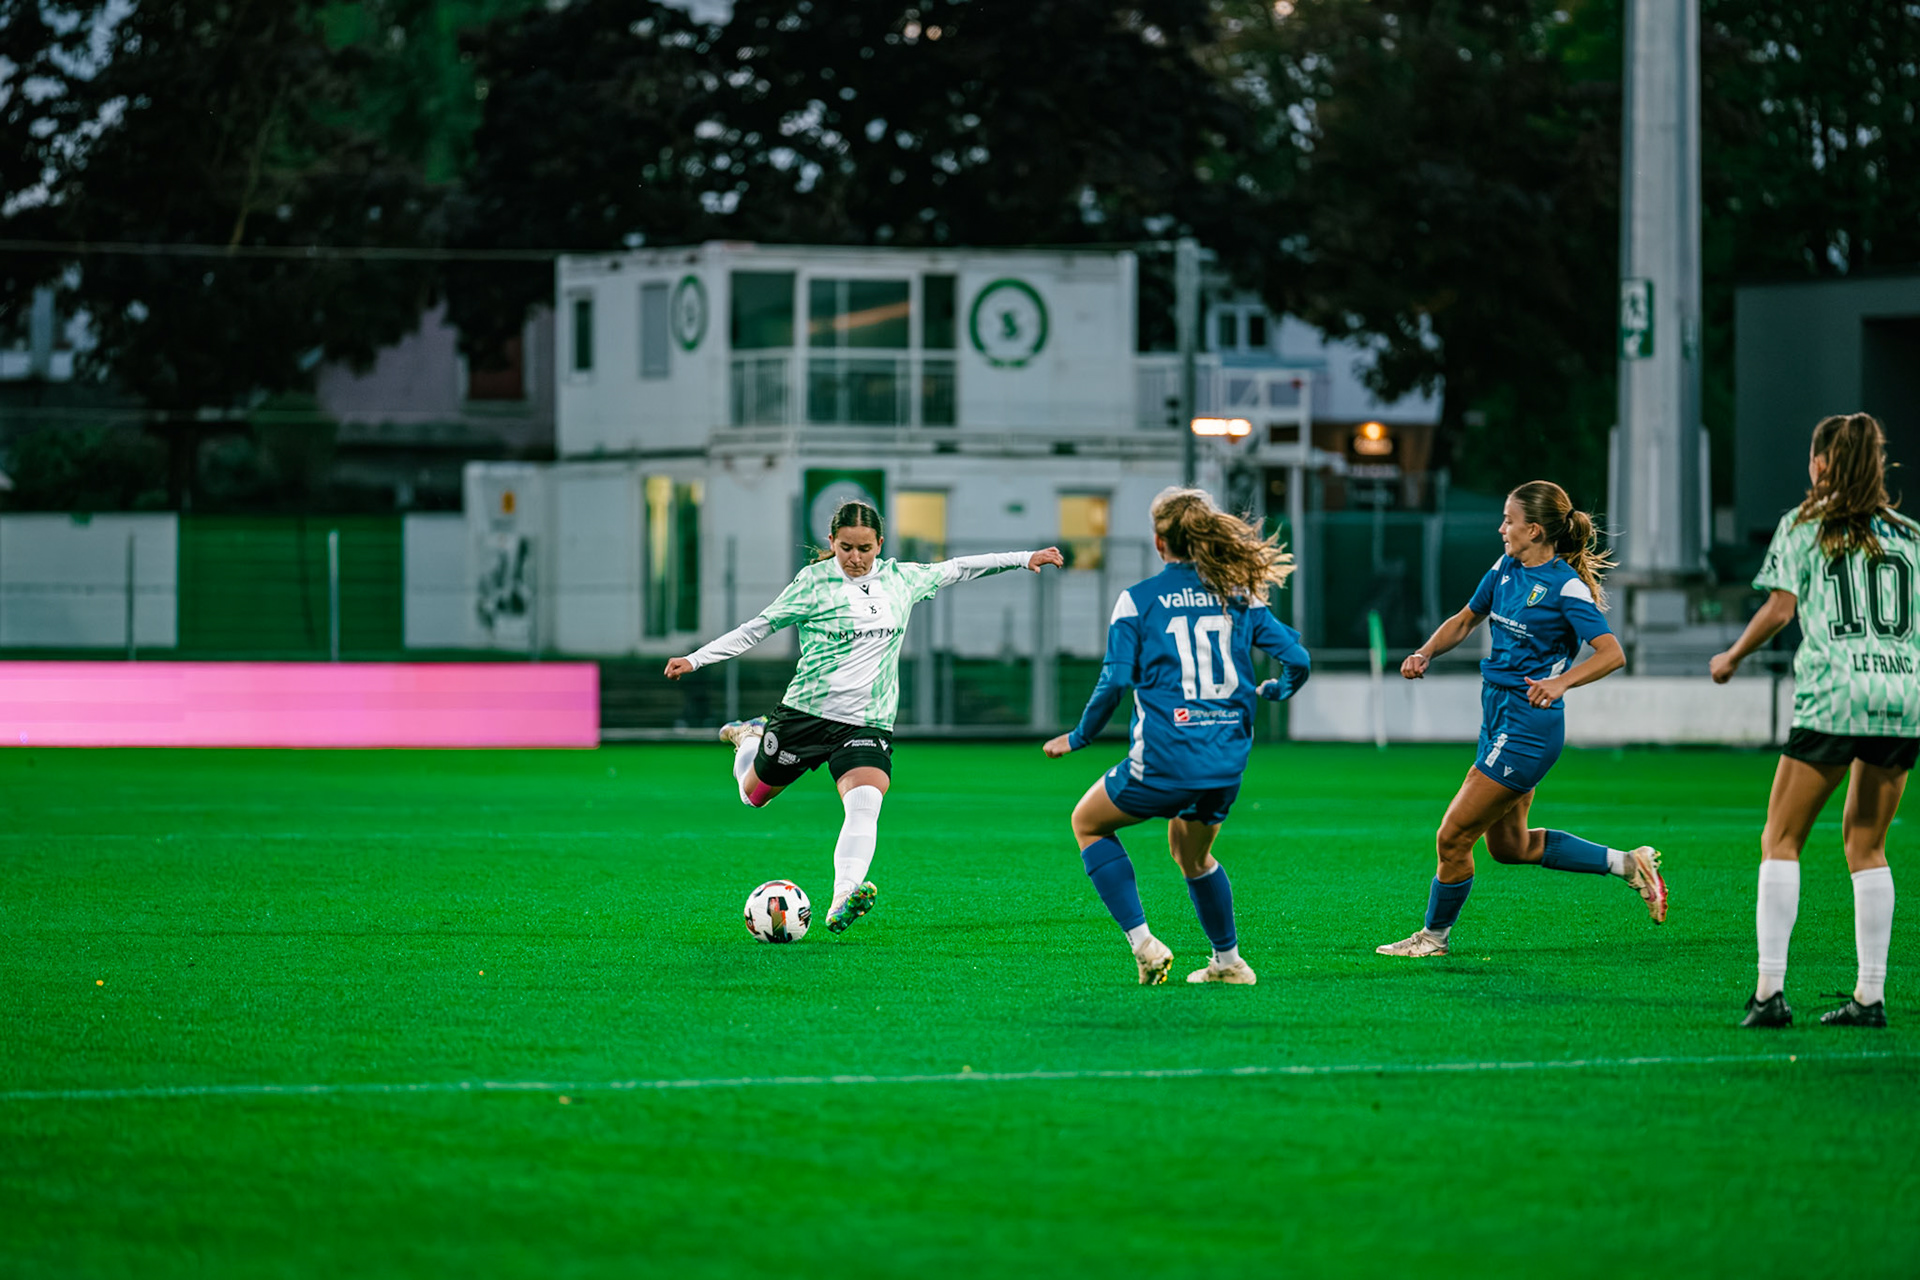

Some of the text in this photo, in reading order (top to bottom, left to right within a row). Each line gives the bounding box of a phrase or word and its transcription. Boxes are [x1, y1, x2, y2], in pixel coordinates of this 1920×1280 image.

[1158, 588, 1221, 608] valian
[1823, 549, 1914, 642] 10
[1165, 615, 1239, 700] 10
[1852, 653, 1913, 674] LE FRANC
